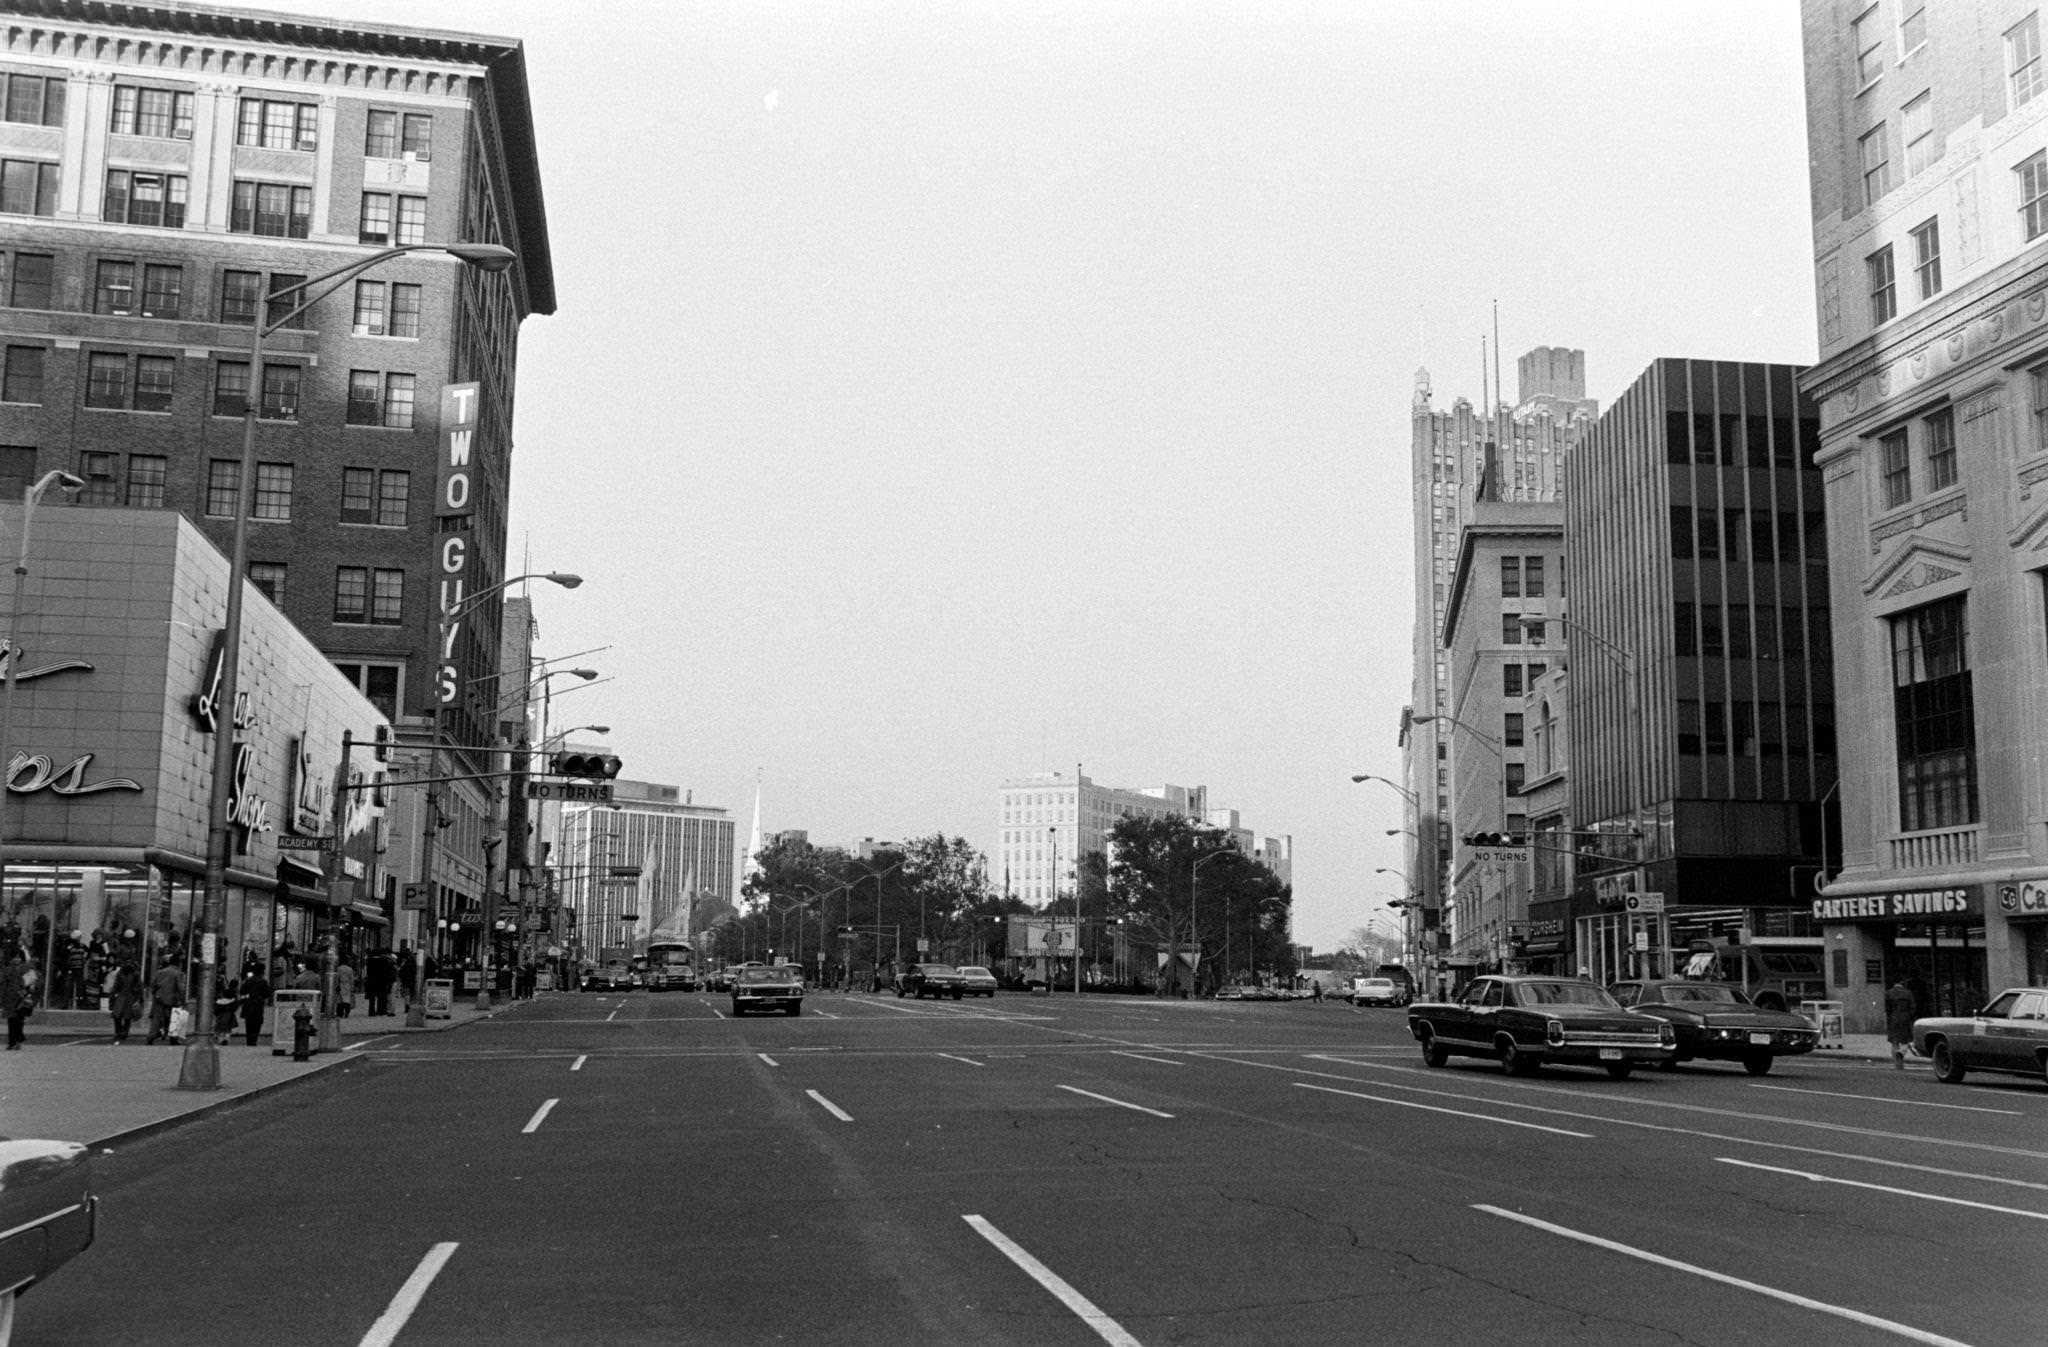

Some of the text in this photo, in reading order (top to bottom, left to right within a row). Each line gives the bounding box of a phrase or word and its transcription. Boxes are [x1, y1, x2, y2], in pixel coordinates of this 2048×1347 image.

[446, 388, 475, 509] TWO
[434, 537, 466, 703] GUYS
[528, 784, 608, 800] NO TURNS
[279, 837, 319, 849] ACADEMY
[1475, 852, 1528, 861] NO TURNS
[1812, 889, 1968, 919] CARTERET SAVINGS
[2022, 883, 2048, 910] Ca
